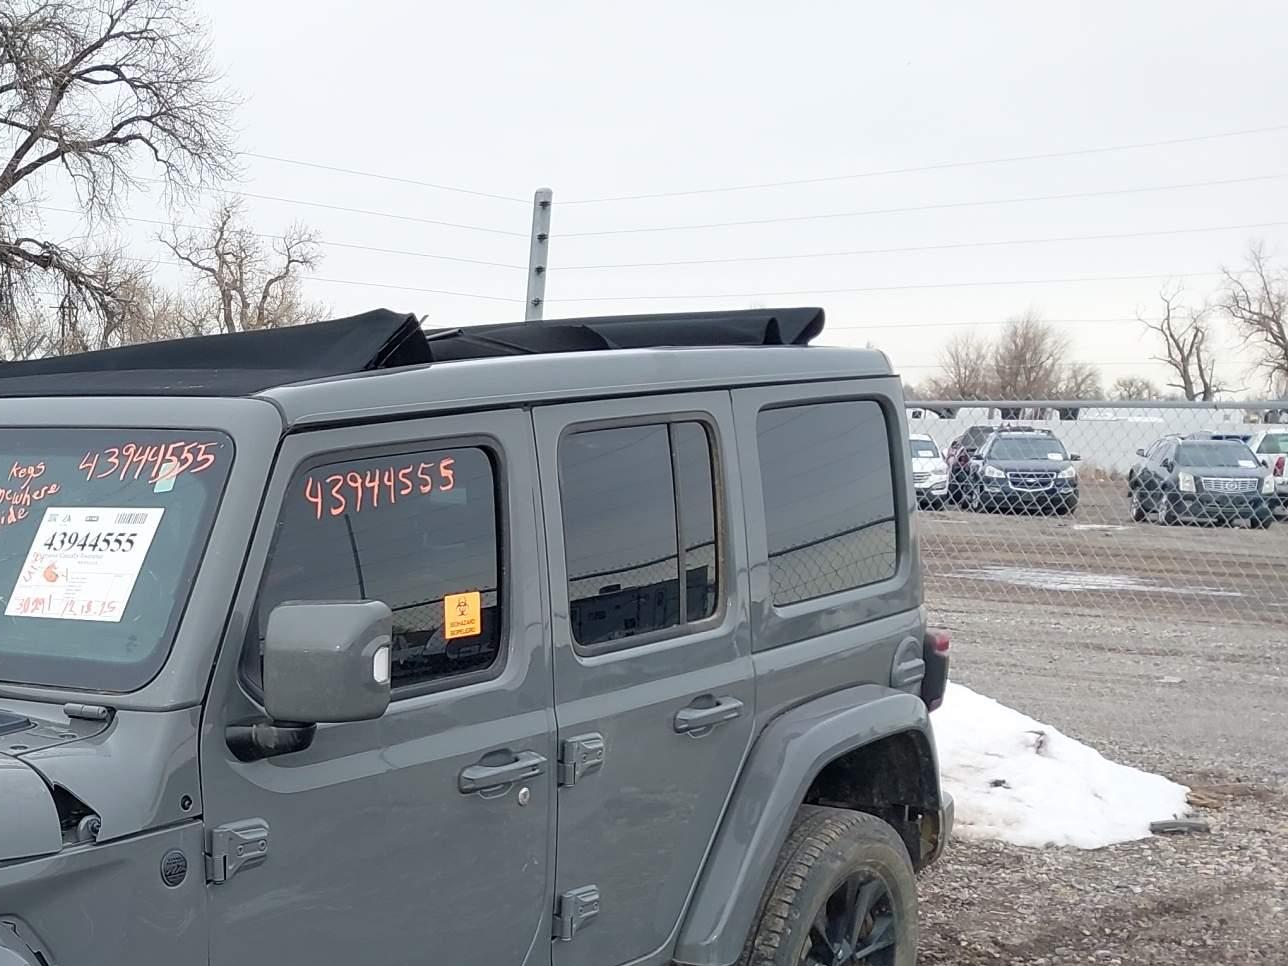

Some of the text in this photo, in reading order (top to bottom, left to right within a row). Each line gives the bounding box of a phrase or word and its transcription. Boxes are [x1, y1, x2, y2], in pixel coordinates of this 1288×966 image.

[79, 442, 217, 481] 43944555
[305, 457, 455, 519] 43944555
[43, 532, 137, 552] 43944555
